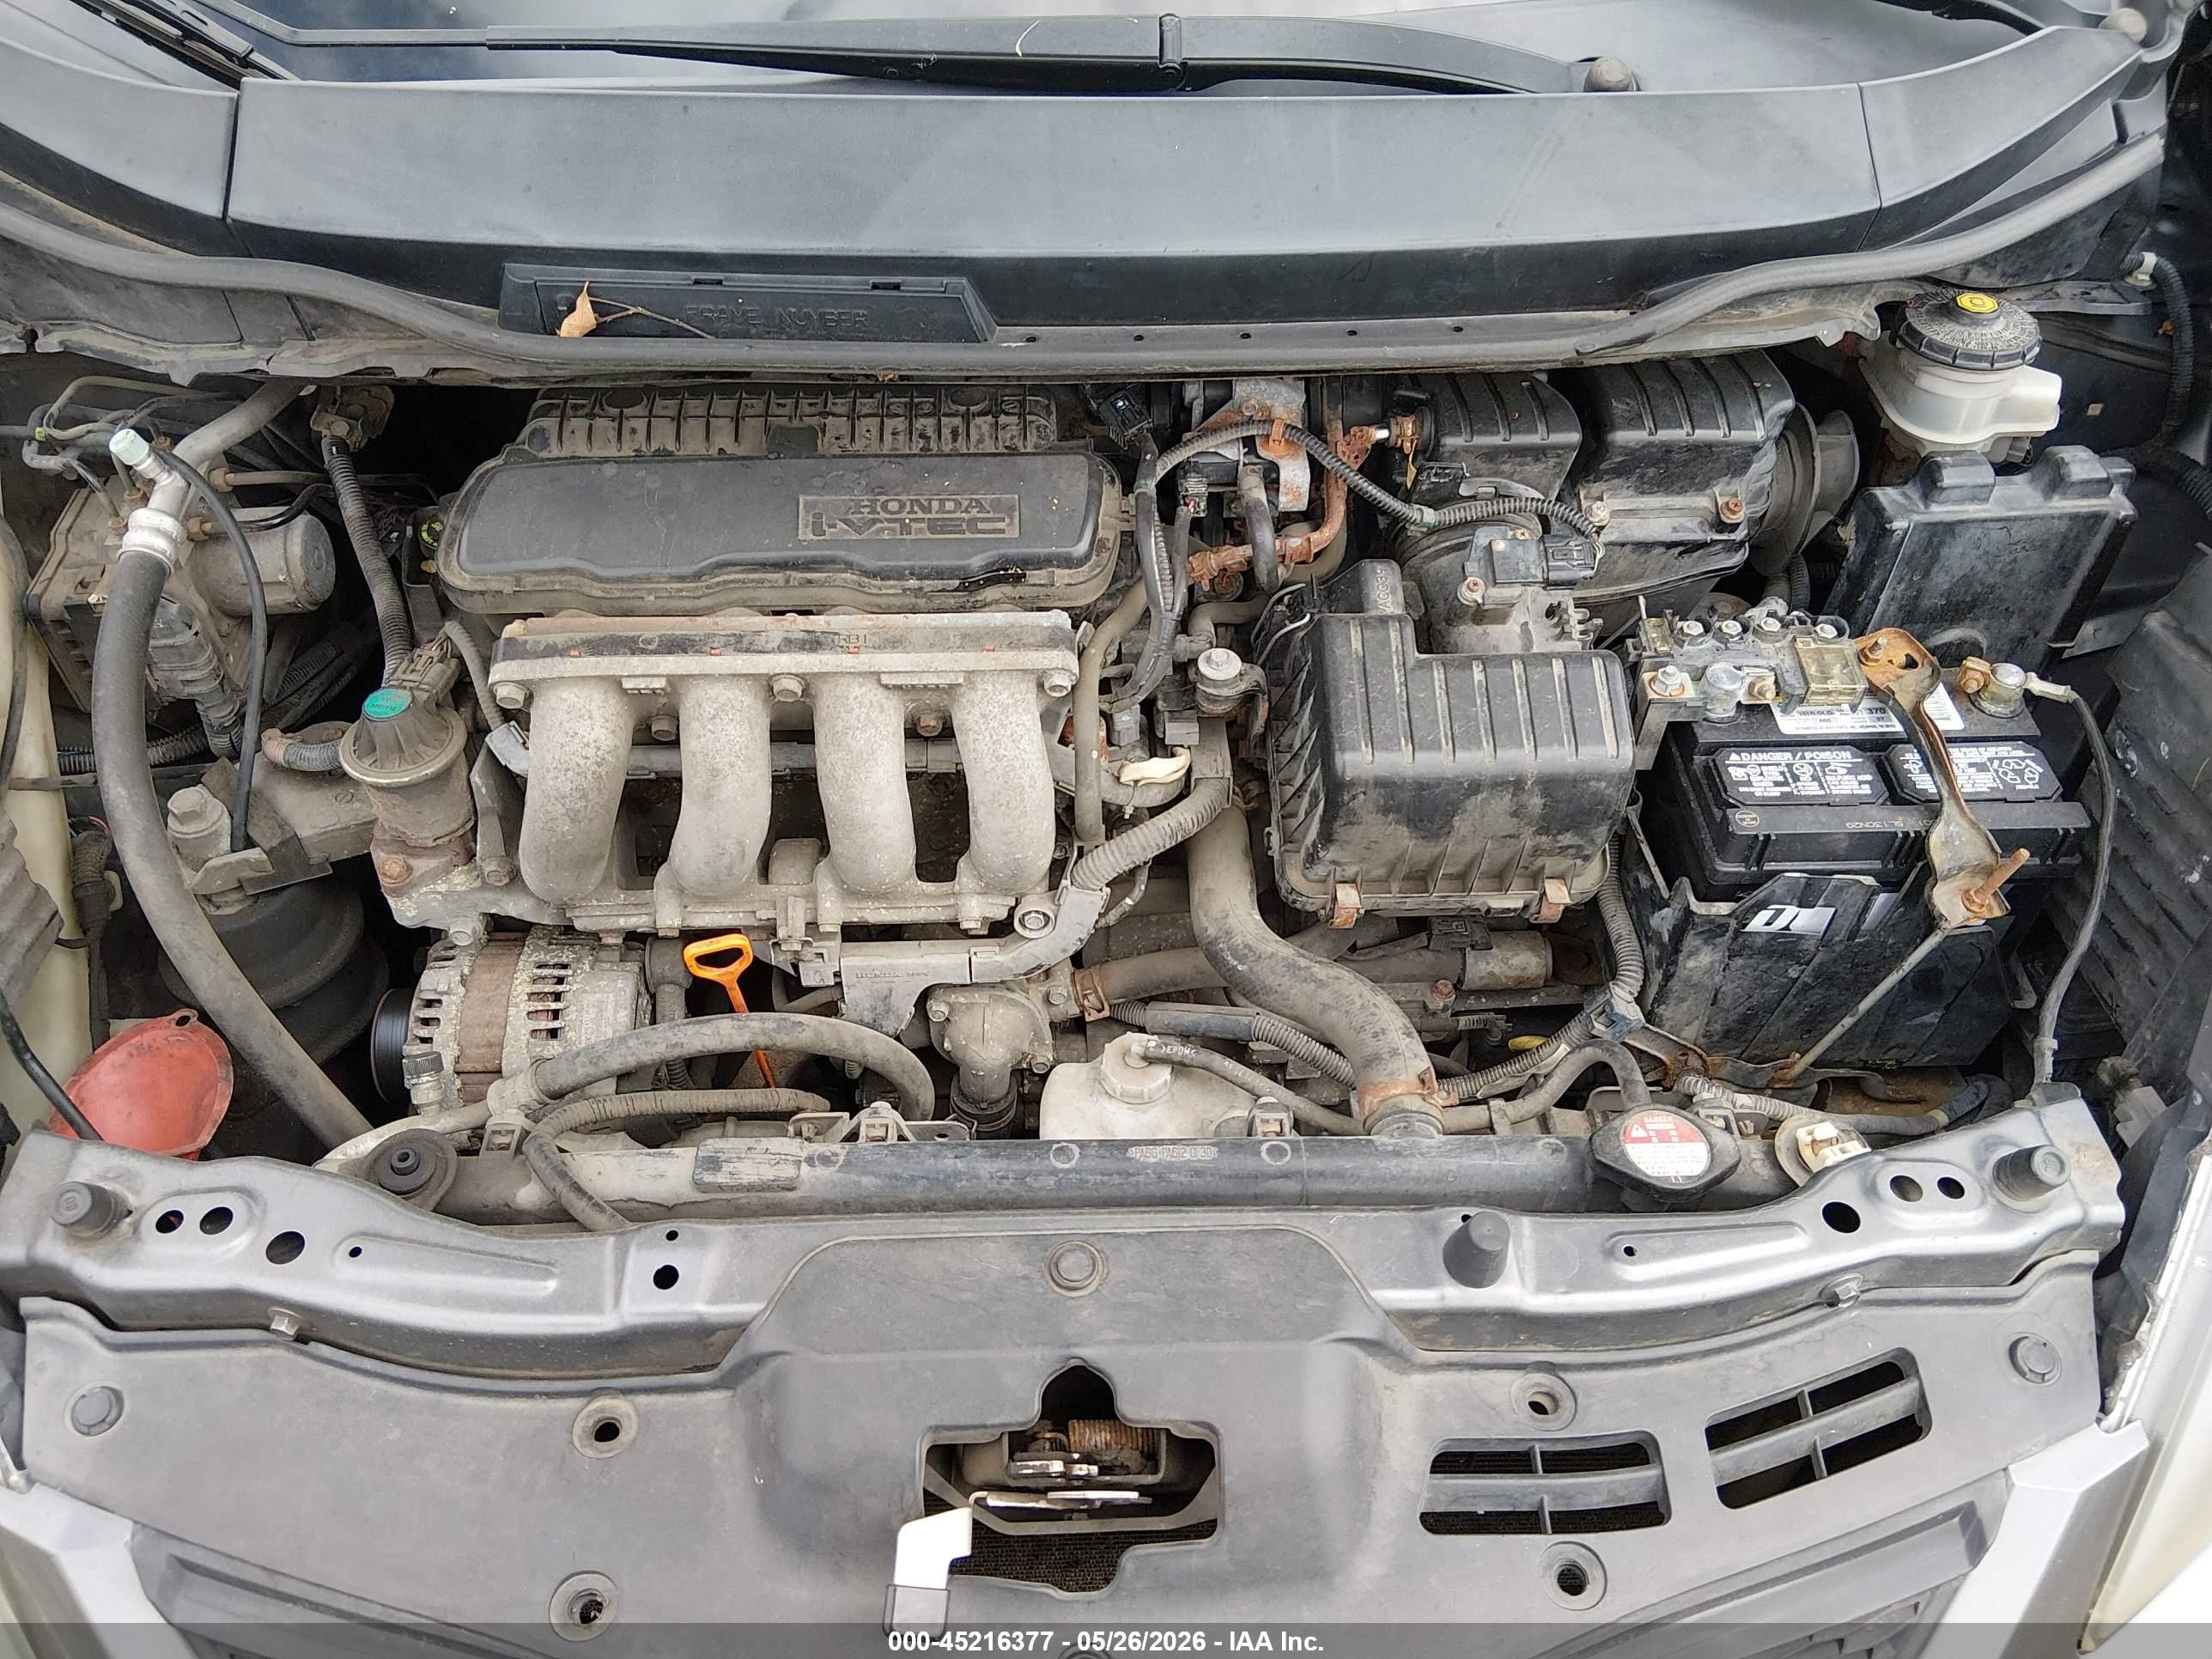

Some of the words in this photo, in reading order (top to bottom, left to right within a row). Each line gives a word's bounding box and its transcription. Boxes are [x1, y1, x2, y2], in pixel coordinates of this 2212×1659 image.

[686, 303, 762, 325] FRAME
[777, 307, 869, 327] NUMBER
[850, 497, 991, 515] HONDA
[811, 512, 1006, 537] i-VTEC
[1741, 752, 1793, 762] DANGER
[1805, 750, 1852, 761] POISON
